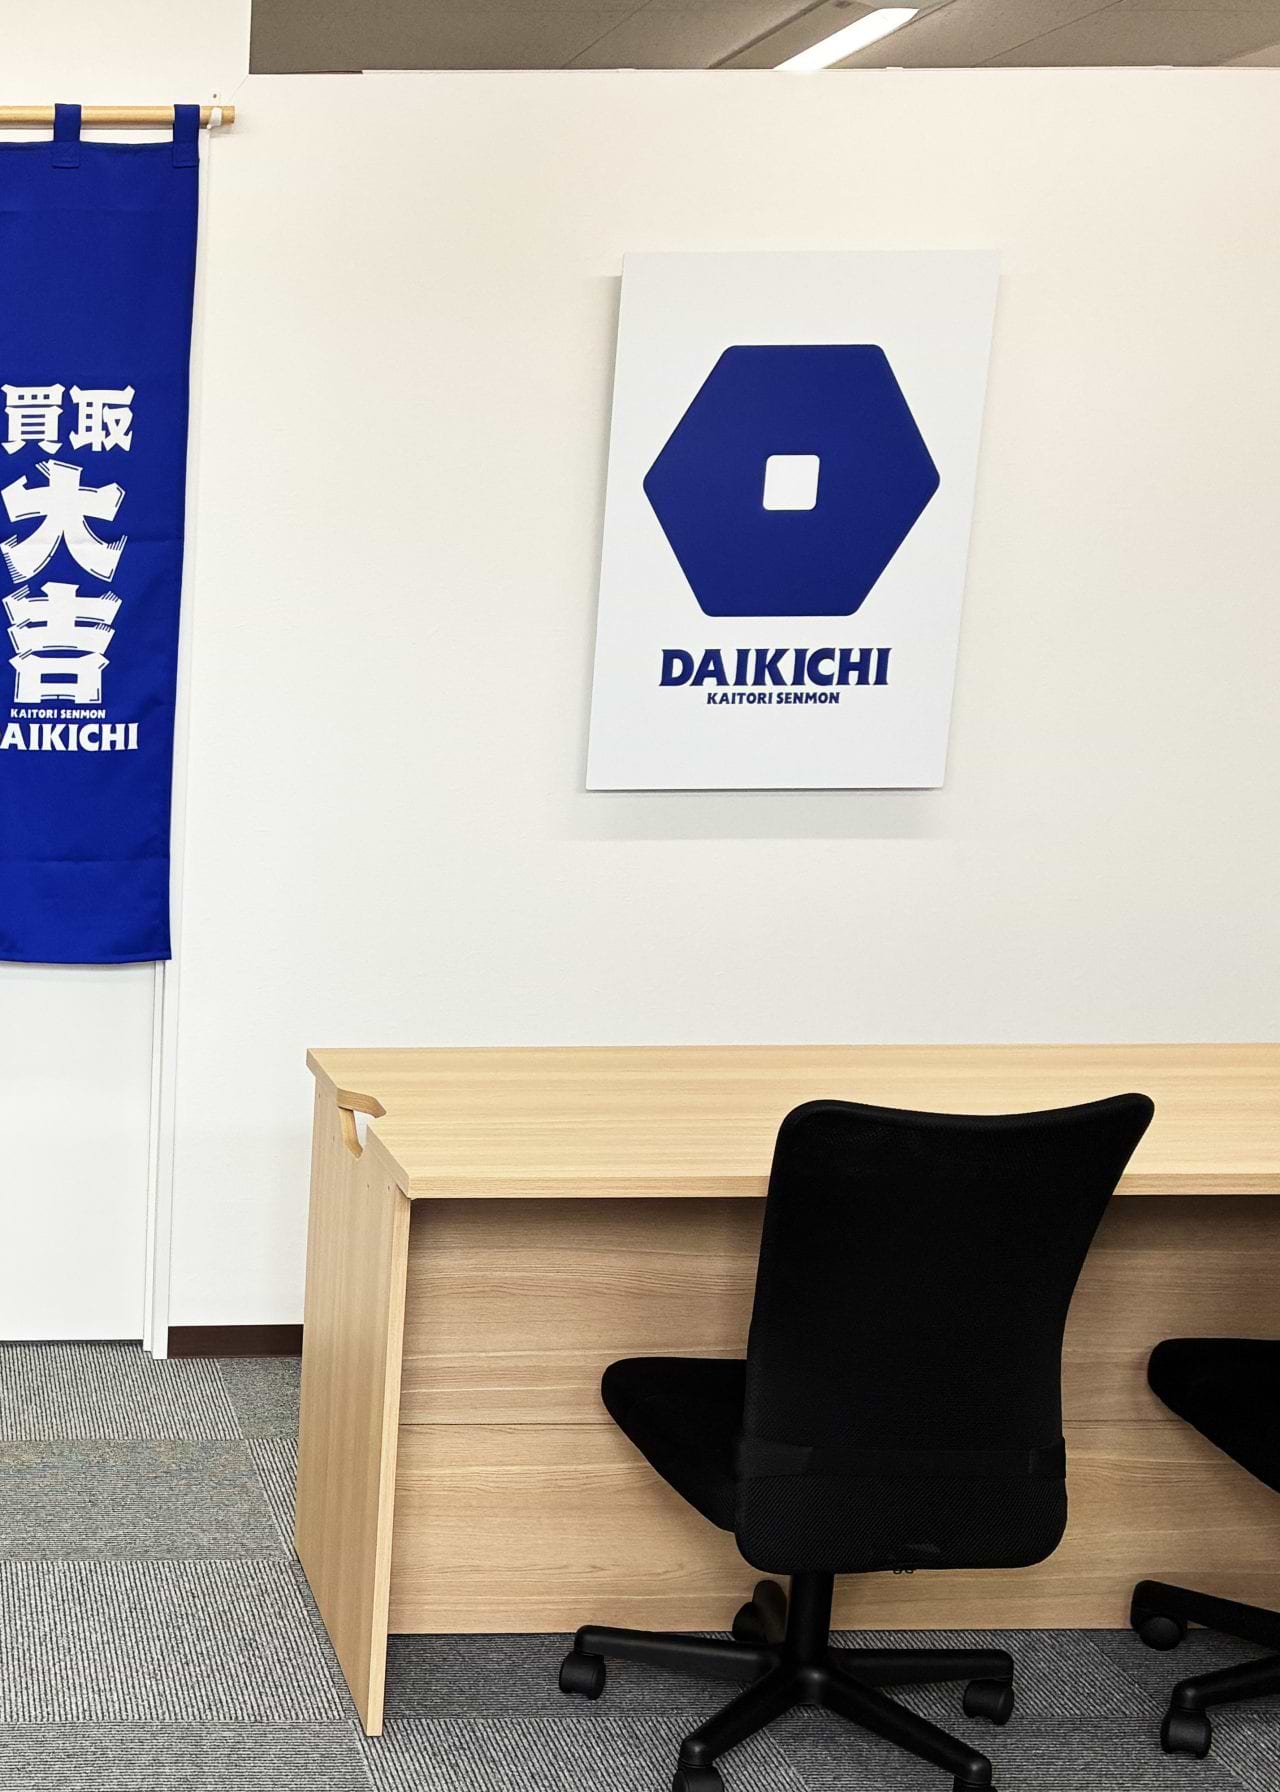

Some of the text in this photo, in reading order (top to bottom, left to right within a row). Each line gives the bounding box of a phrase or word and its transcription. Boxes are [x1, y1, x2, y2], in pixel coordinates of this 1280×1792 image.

[0, 383, 136, 455] 買取
[0, 459, 128, 704] 大吉
[659, 647, 893, 687] DAIKICHI
[10, 708, 106, 719] KAITORI SENMON
[707, 692, 840, 705] KAITORI SENMON
